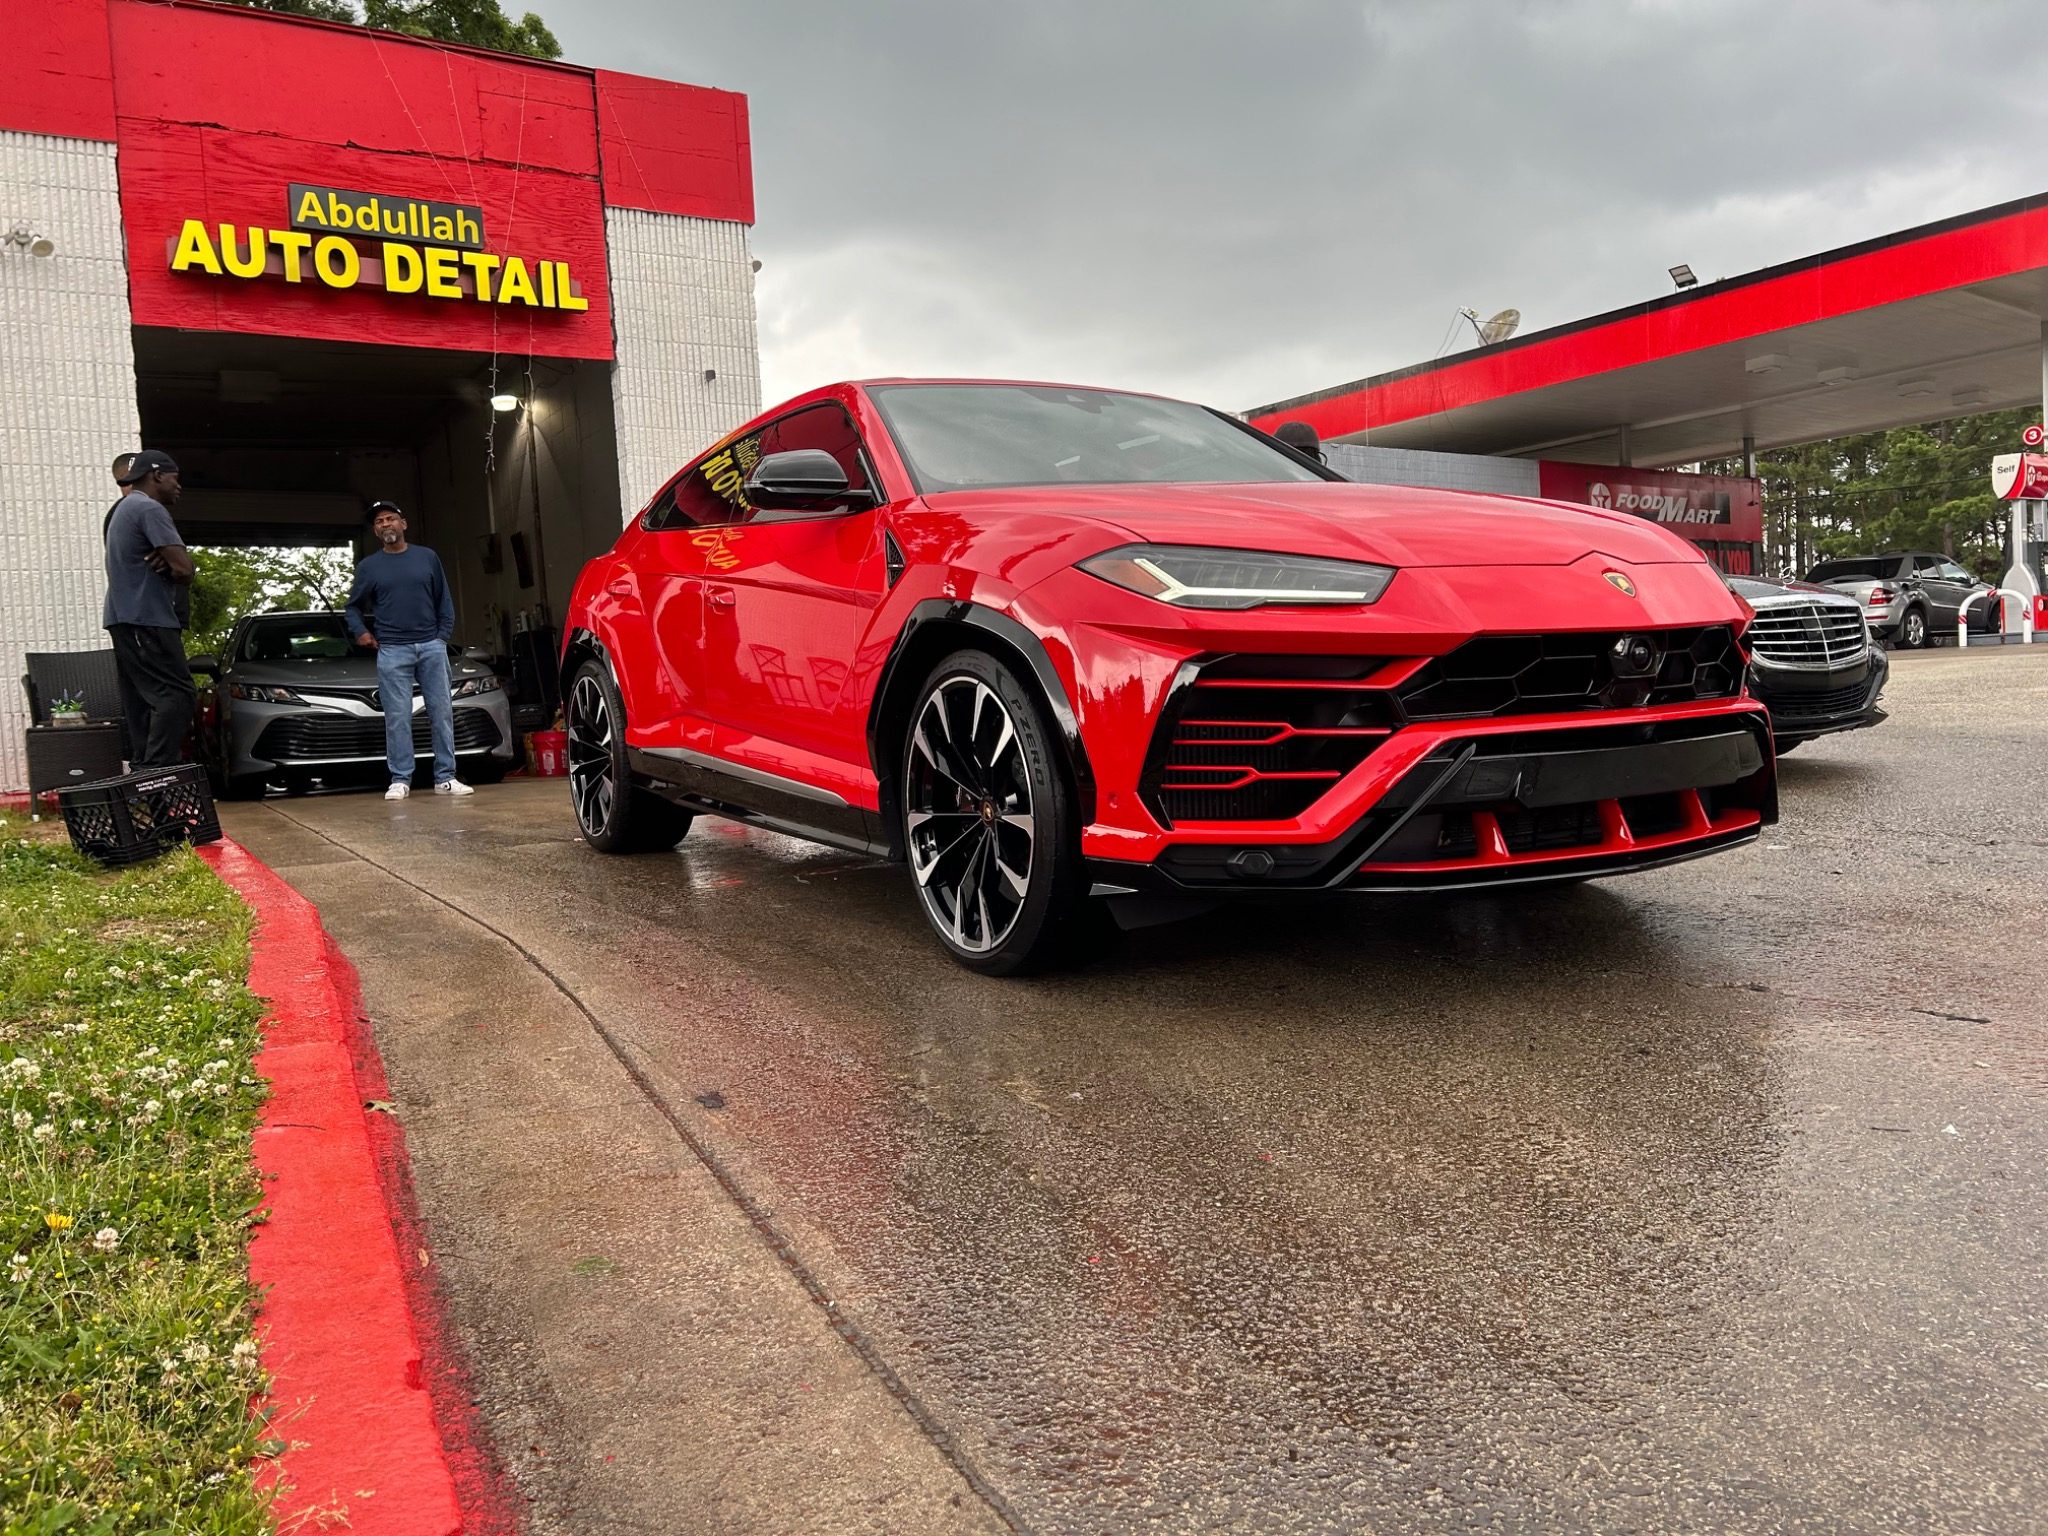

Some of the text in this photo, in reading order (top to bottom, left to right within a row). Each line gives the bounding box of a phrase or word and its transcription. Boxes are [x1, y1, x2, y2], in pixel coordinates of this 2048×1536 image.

[297, 191, 480, 244] Abdullah
[171, 218, 589, 311] AUTO DETAIL
[2029, 430, 2038, 440] 3
[1997, 465, 2015, 474] Self
[1020, 716, 1045, 786] ZERO
